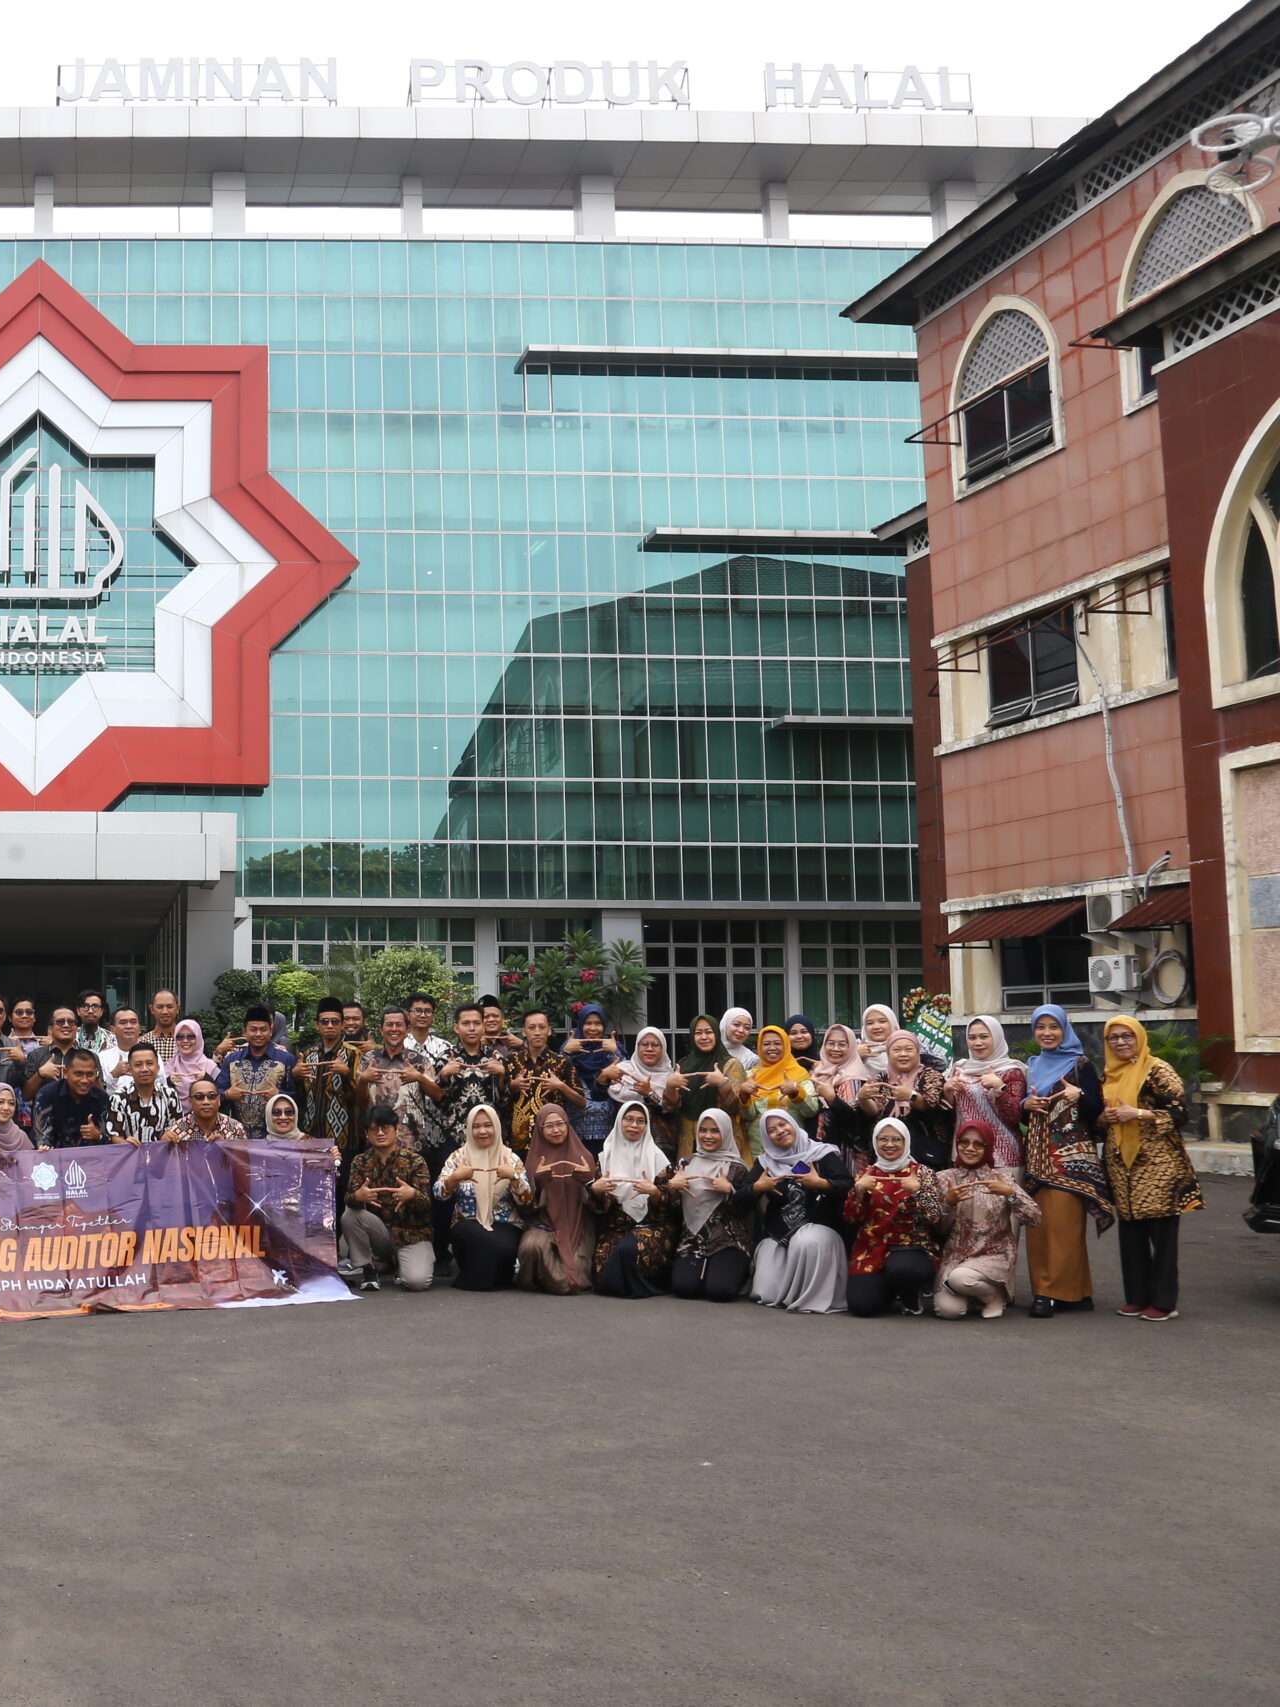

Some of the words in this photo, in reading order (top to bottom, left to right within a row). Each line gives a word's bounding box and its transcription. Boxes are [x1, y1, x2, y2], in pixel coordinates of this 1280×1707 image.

[56, 57, 337, 102] JAMINAN
[410, 58, 691, 105] PRODUK
[765, 63, 974, 110] HALAL
[0, 1217, 66, 1234] Stronger
[66, 1215, 132, 1231] Together
[23, 1230, 137, 1272] AUDITOR
[142, 1225, 266, 1265] NASIONAL
[27, 1272, 147, 1290] HIDAYATULLAH
